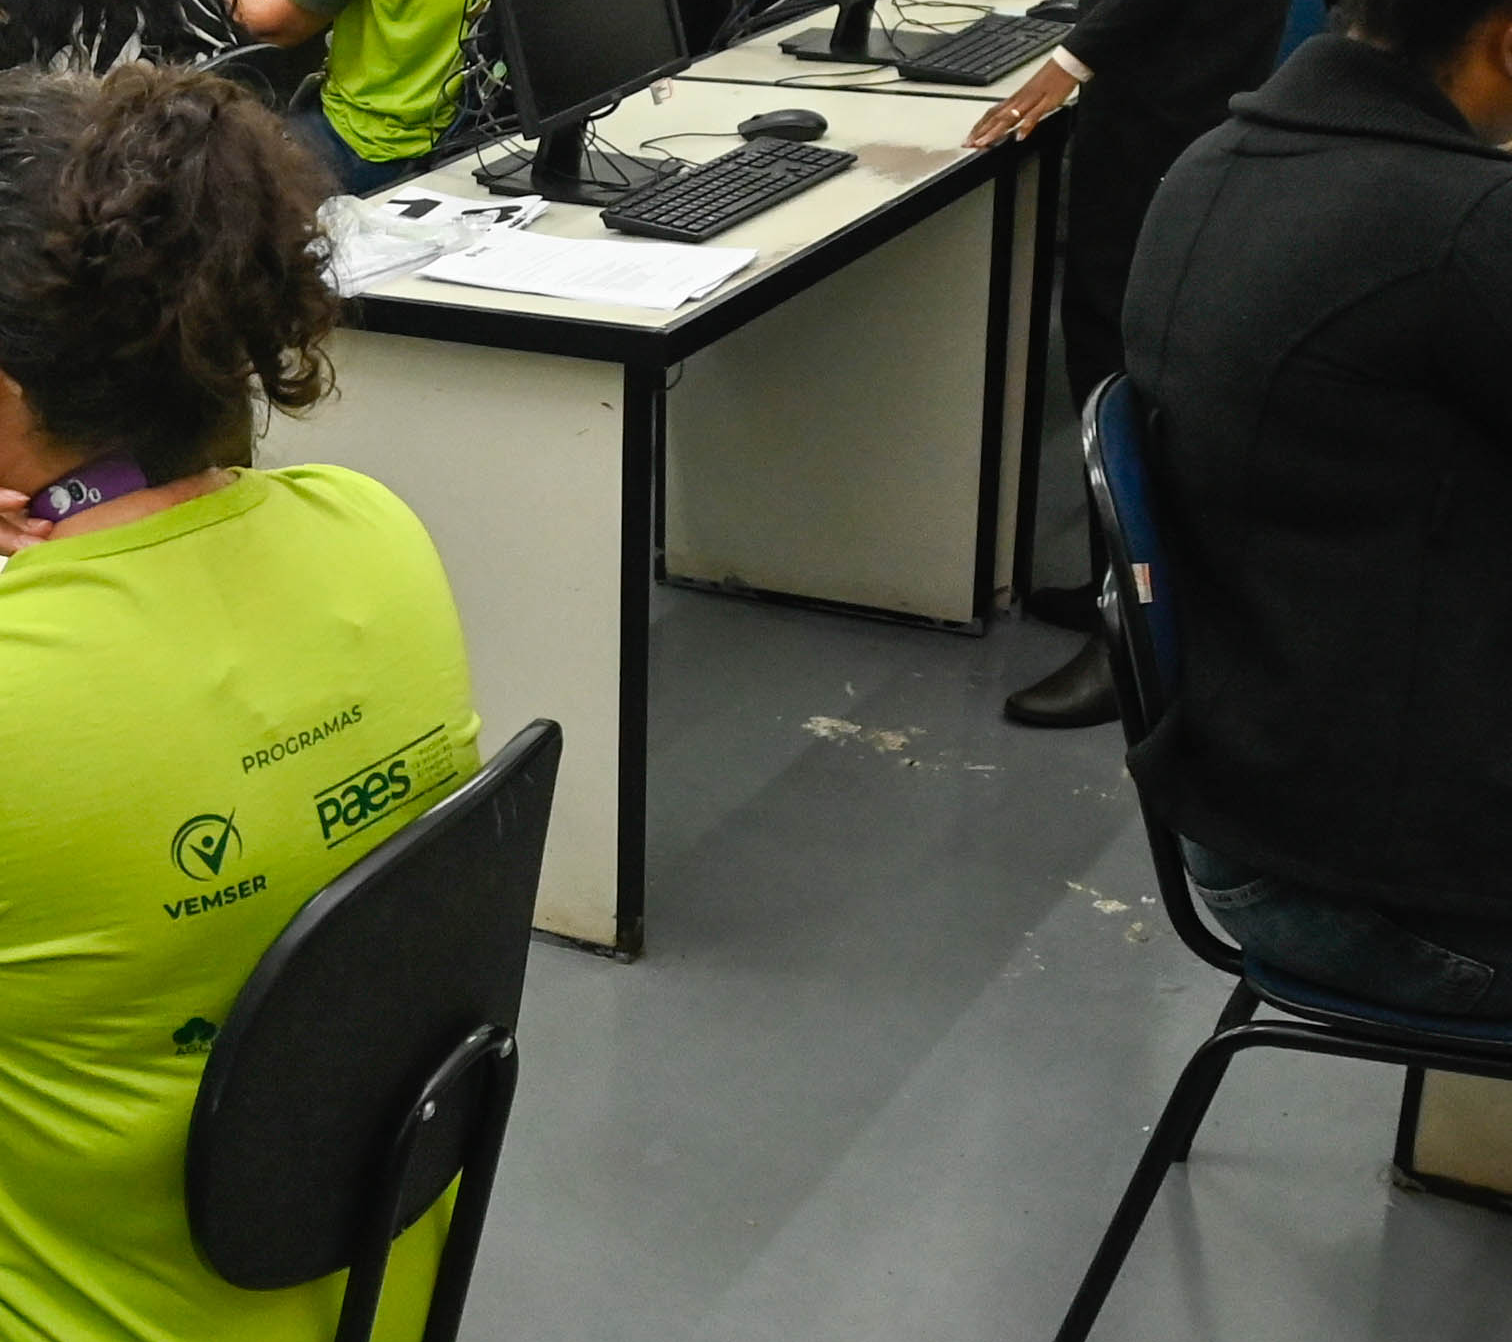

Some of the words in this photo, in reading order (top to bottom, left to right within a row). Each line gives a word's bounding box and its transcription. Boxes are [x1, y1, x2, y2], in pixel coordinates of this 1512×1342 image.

[241, 704, 363, 775] PROGRAMAS
[316, 759, 412, 840] paes
[162, 874, 268, 921] VEMSER
